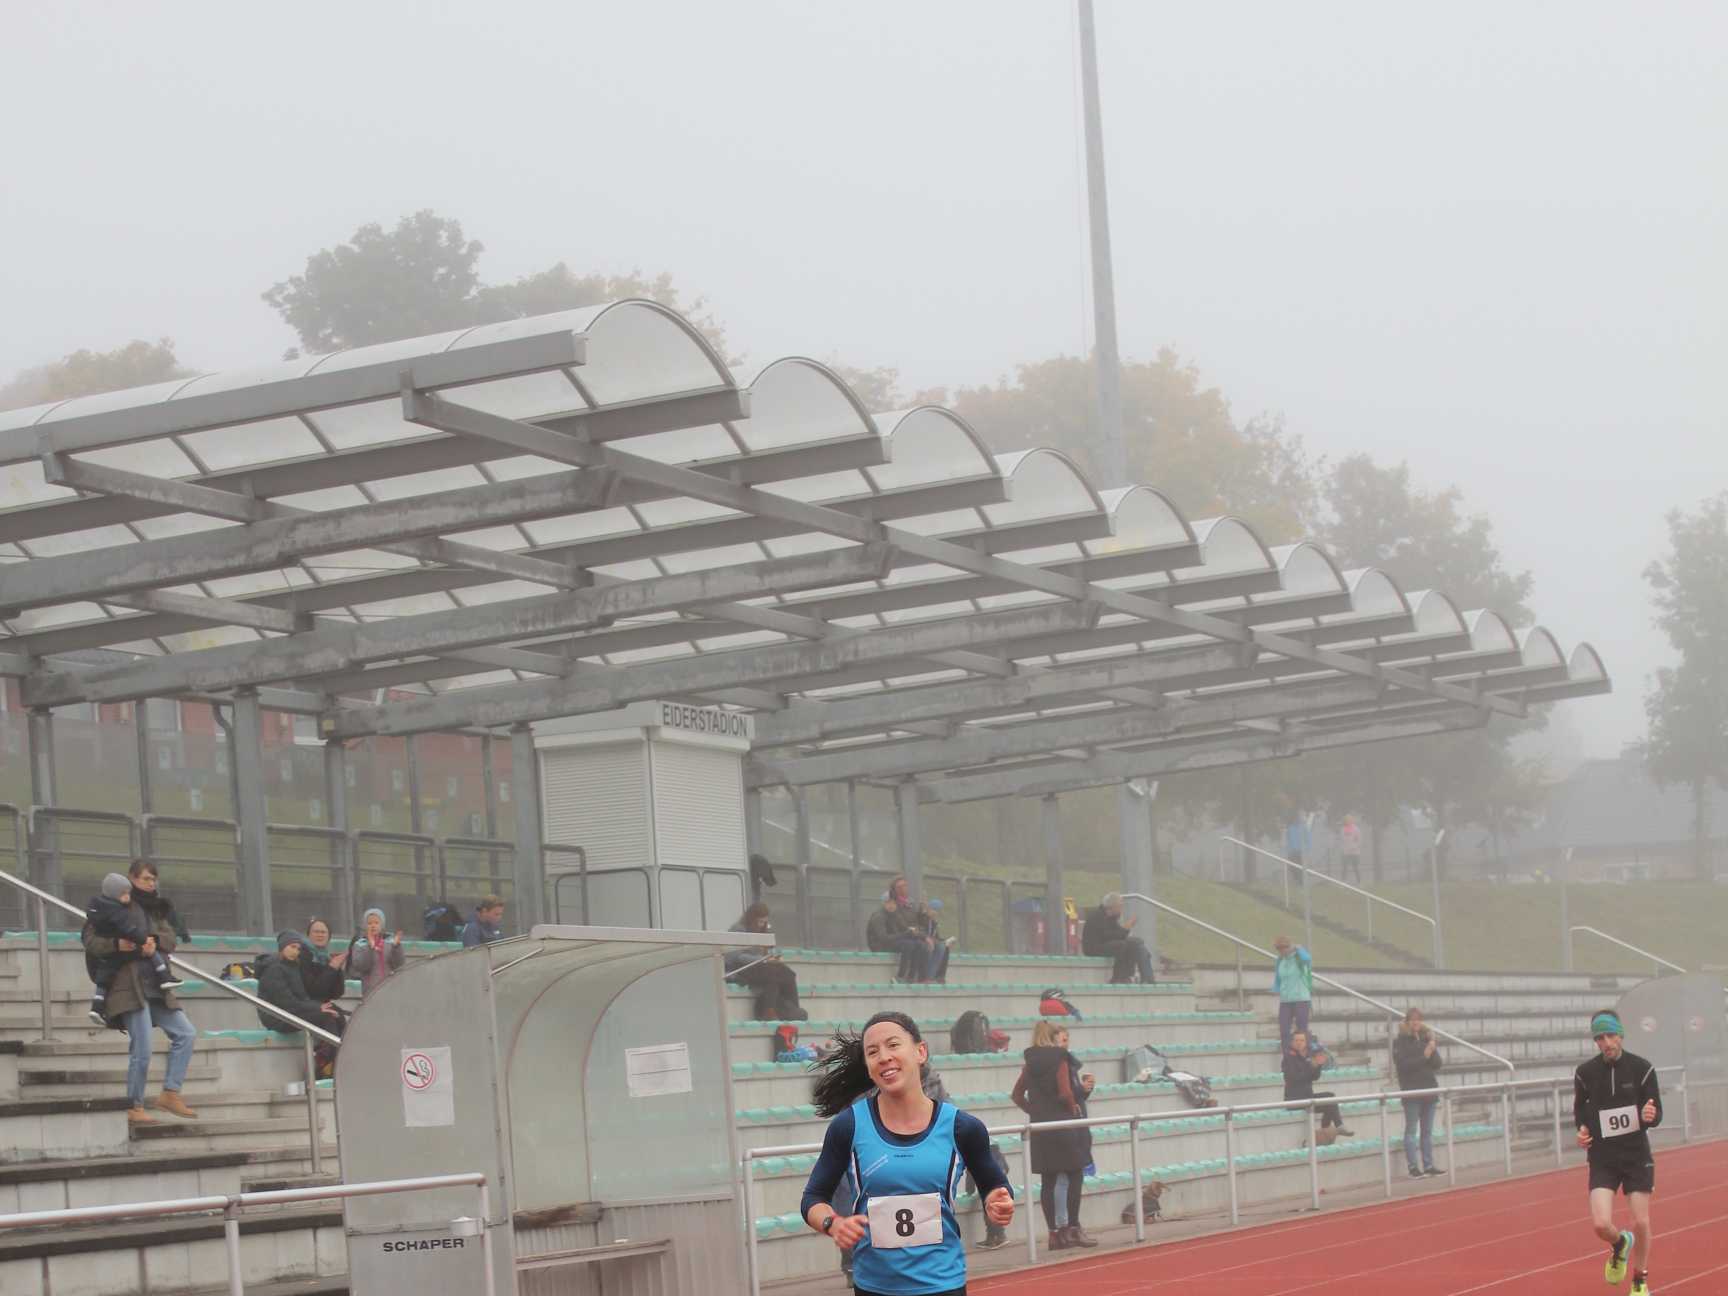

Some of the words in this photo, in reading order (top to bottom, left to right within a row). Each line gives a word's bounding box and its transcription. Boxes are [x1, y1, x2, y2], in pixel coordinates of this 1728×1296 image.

[663, 703, 748, 737] EIDERSTADION
[1609, 1113, 1630, 1130] 90
[895, 1208, 915, 1237] 8
